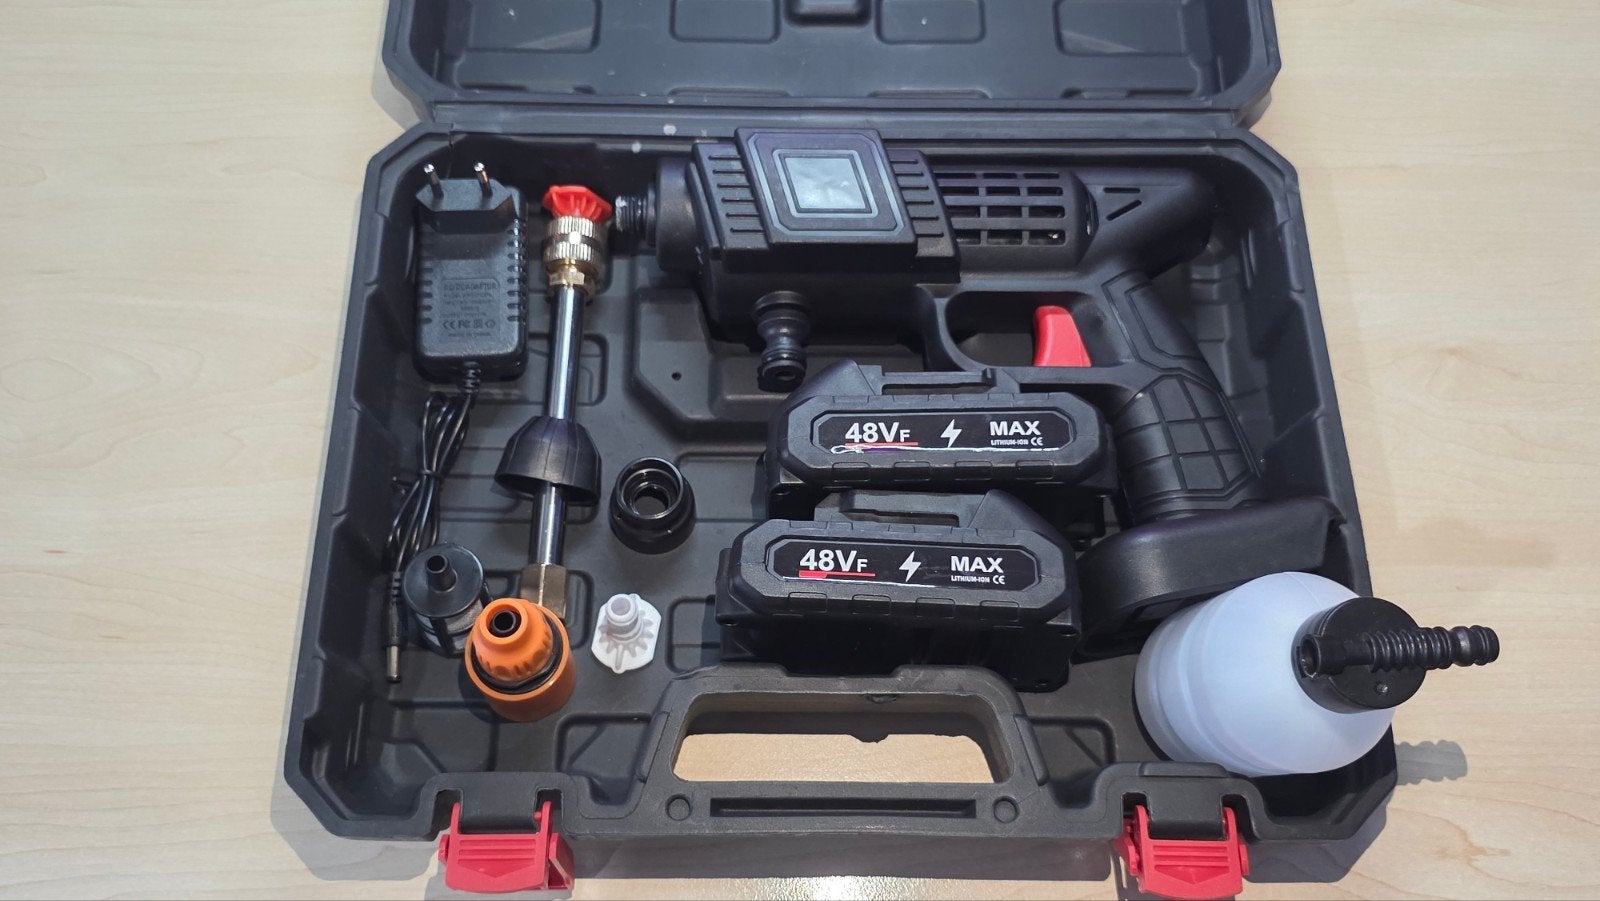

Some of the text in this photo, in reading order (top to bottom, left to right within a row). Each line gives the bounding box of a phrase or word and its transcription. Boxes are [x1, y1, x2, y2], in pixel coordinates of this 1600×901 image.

[989, 420, 1042, 436] MAX
[990, 436, 1044, 446] LITHIUM-ION CE
[950, 555, 1004, 573] MAX
[950, 574, 1006, 585] LITHIUM-ION CE
